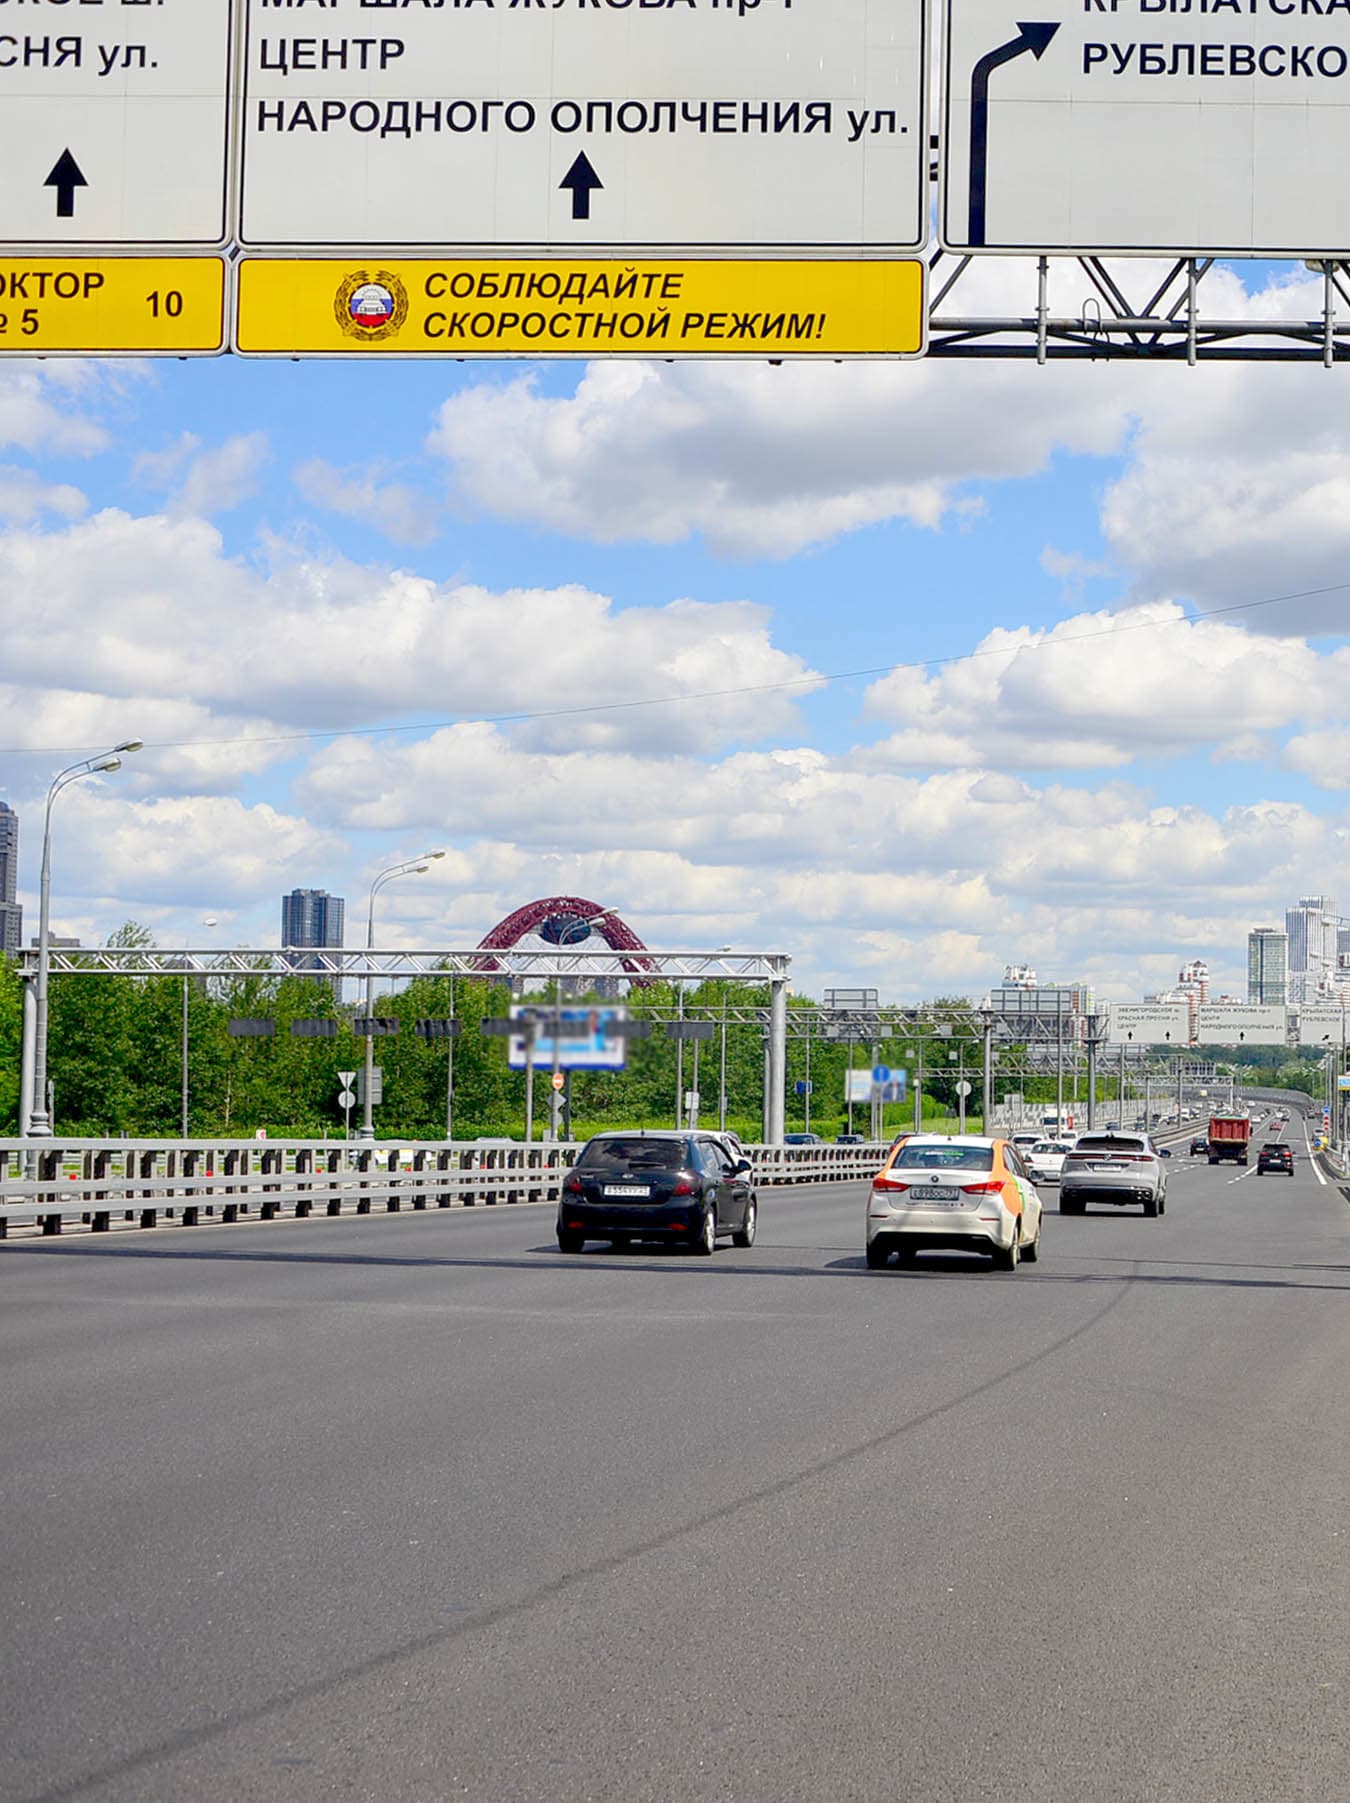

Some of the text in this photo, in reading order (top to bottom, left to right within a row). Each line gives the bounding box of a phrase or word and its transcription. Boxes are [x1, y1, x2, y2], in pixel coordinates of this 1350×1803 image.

[97, 45, 158, 76] ул.
[259, 38, 405, 76] ЦЕНТР
[257, 100, 908, 142] НАРОДНОГО ОПОЛЧЕНИЯ ул.
[0, 272, 105, 299] КТОР
[424, 267, 684, 305] СОБЛЮДАЙТЕ
[146, 291, 183, 318] 10
[423, 307, 827, 339] СКОРОСТНОЙ РЕЖИМ!
